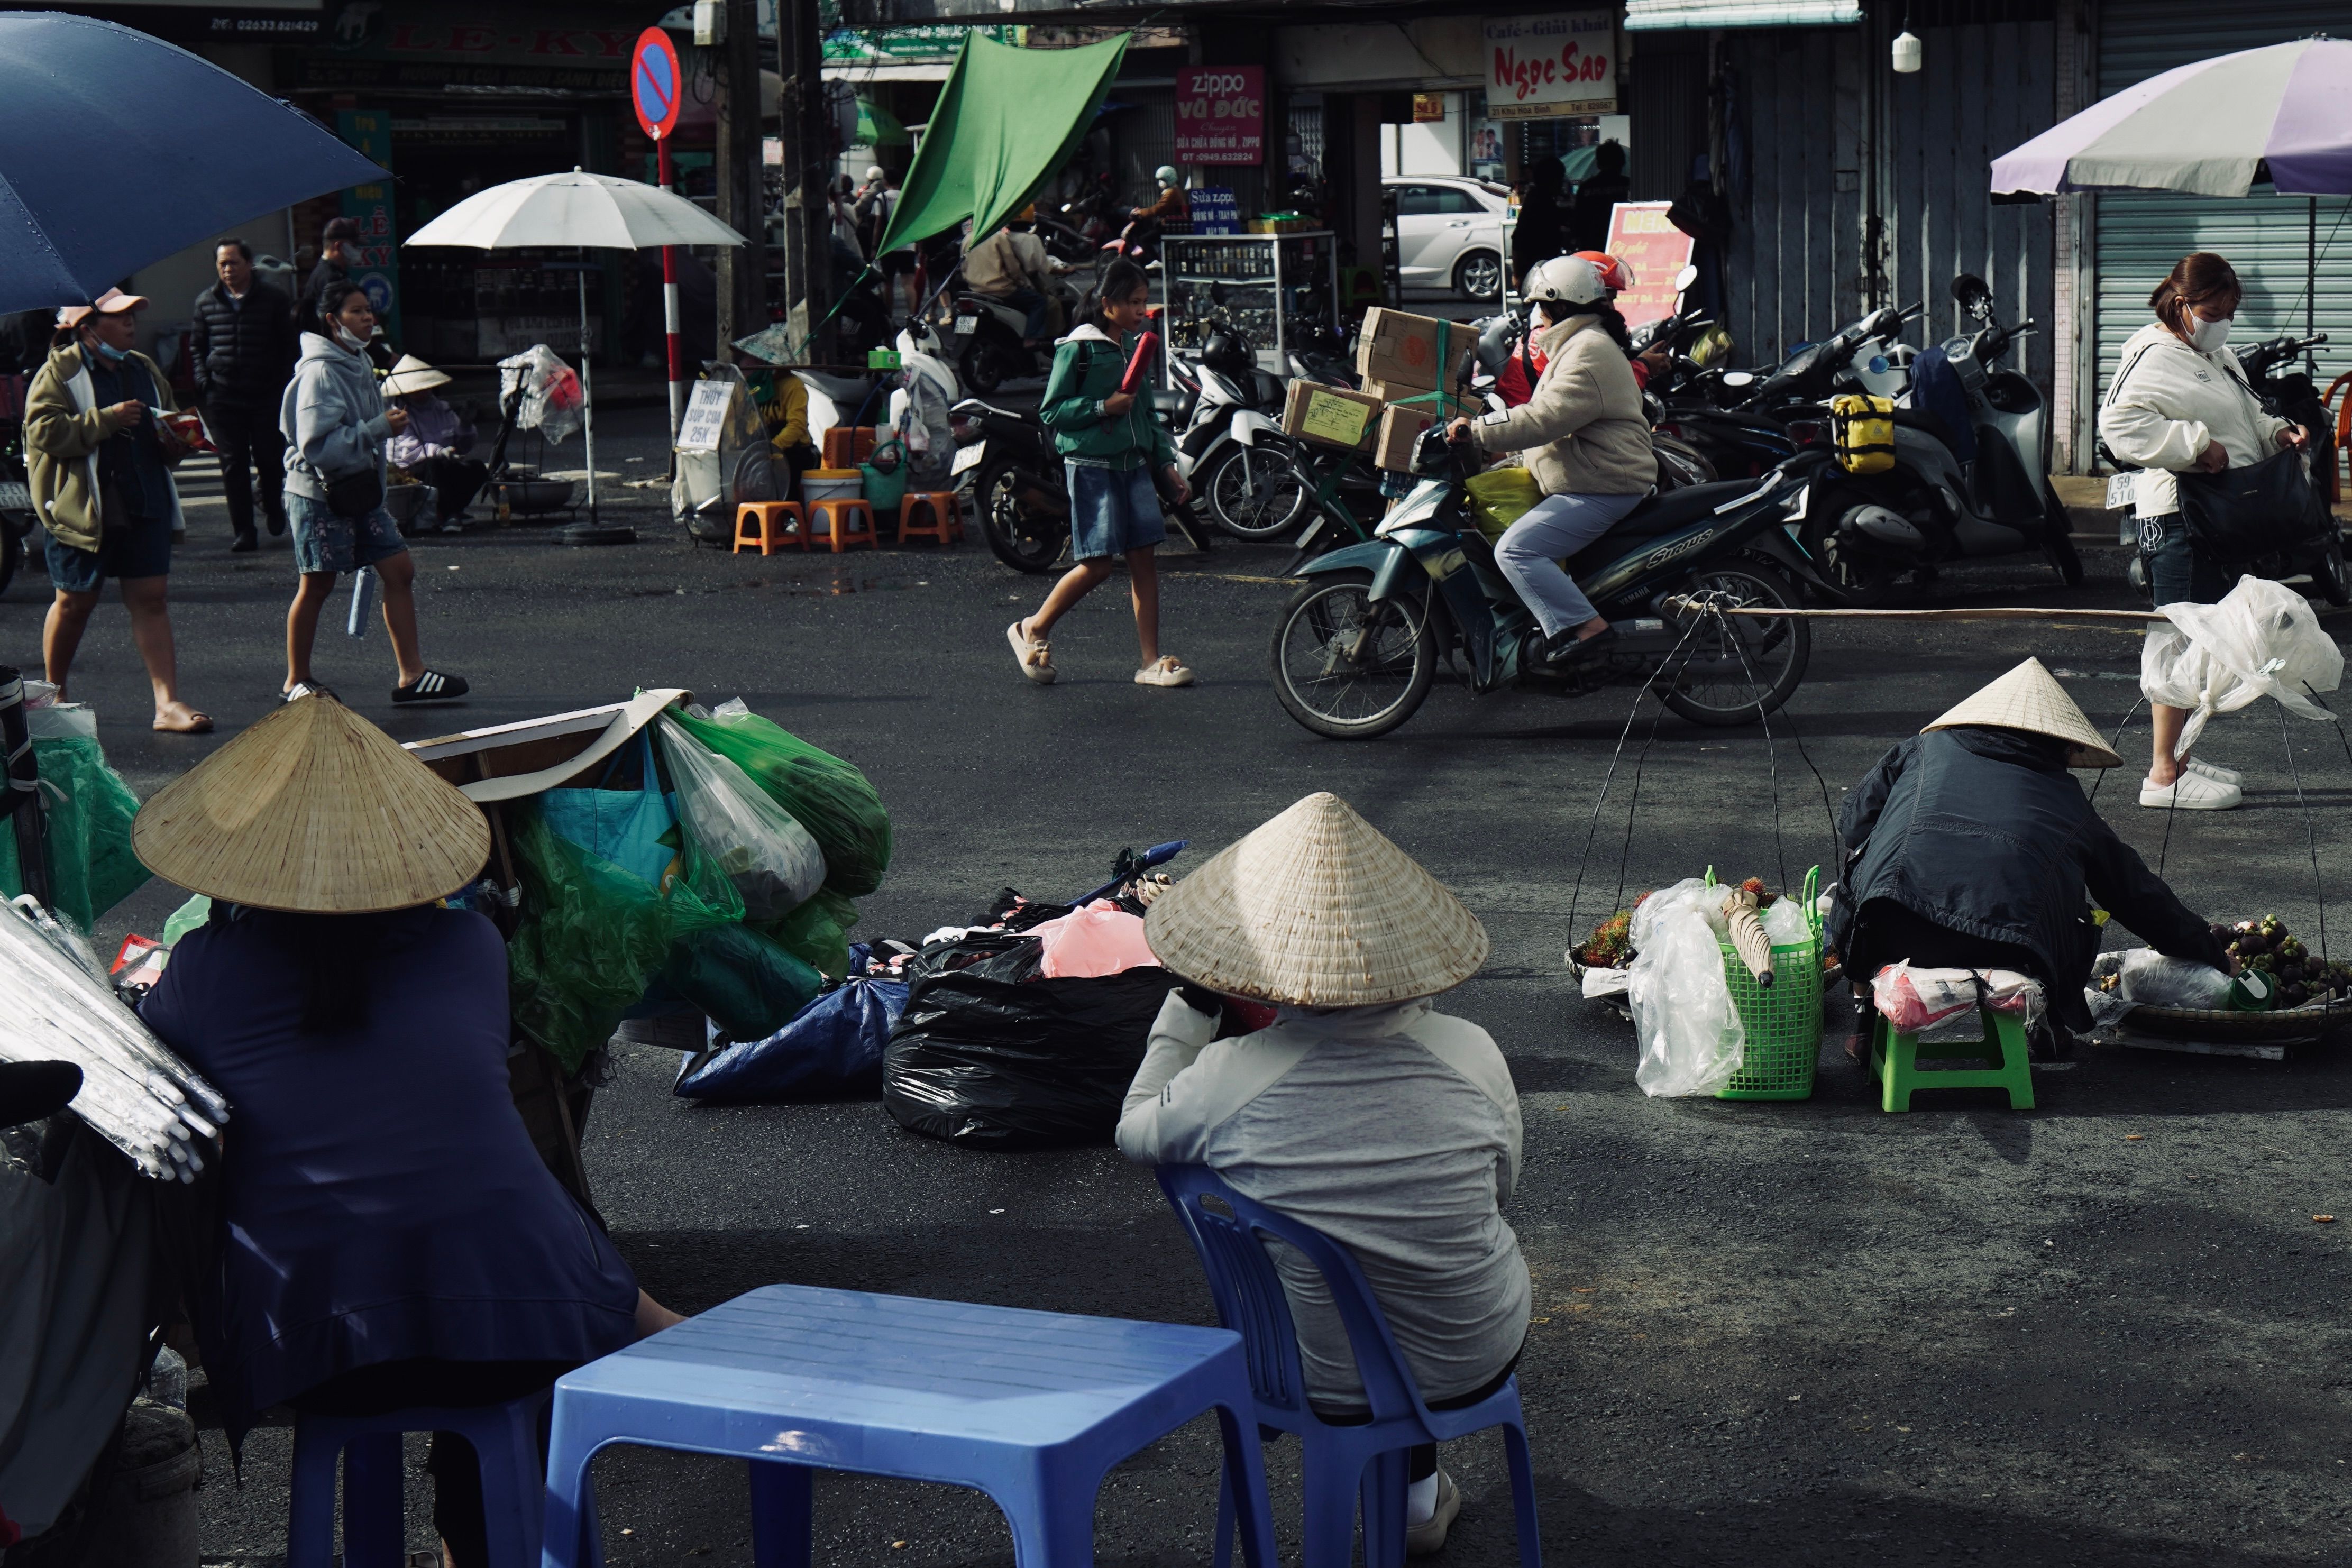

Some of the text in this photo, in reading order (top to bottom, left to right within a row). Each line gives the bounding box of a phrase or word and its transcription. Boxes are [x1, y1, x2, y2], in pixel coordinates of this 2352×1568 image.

[1487, 22, 1522, 39] Café
[1495, 41, 1607, 100] Ngọc Sao
[1191, 71, 1245, 98] zippo
[1502, 106, 1516, 115] Khu
[1242, 135, 1260, 148] ZIPPO
[1191, 190, 1211, 204] Sửa
[1664, 276, 1676, 286] 20
[690, 426, 710, 443] 25K
[1618, 585, 1651, 606] YAMAHA
